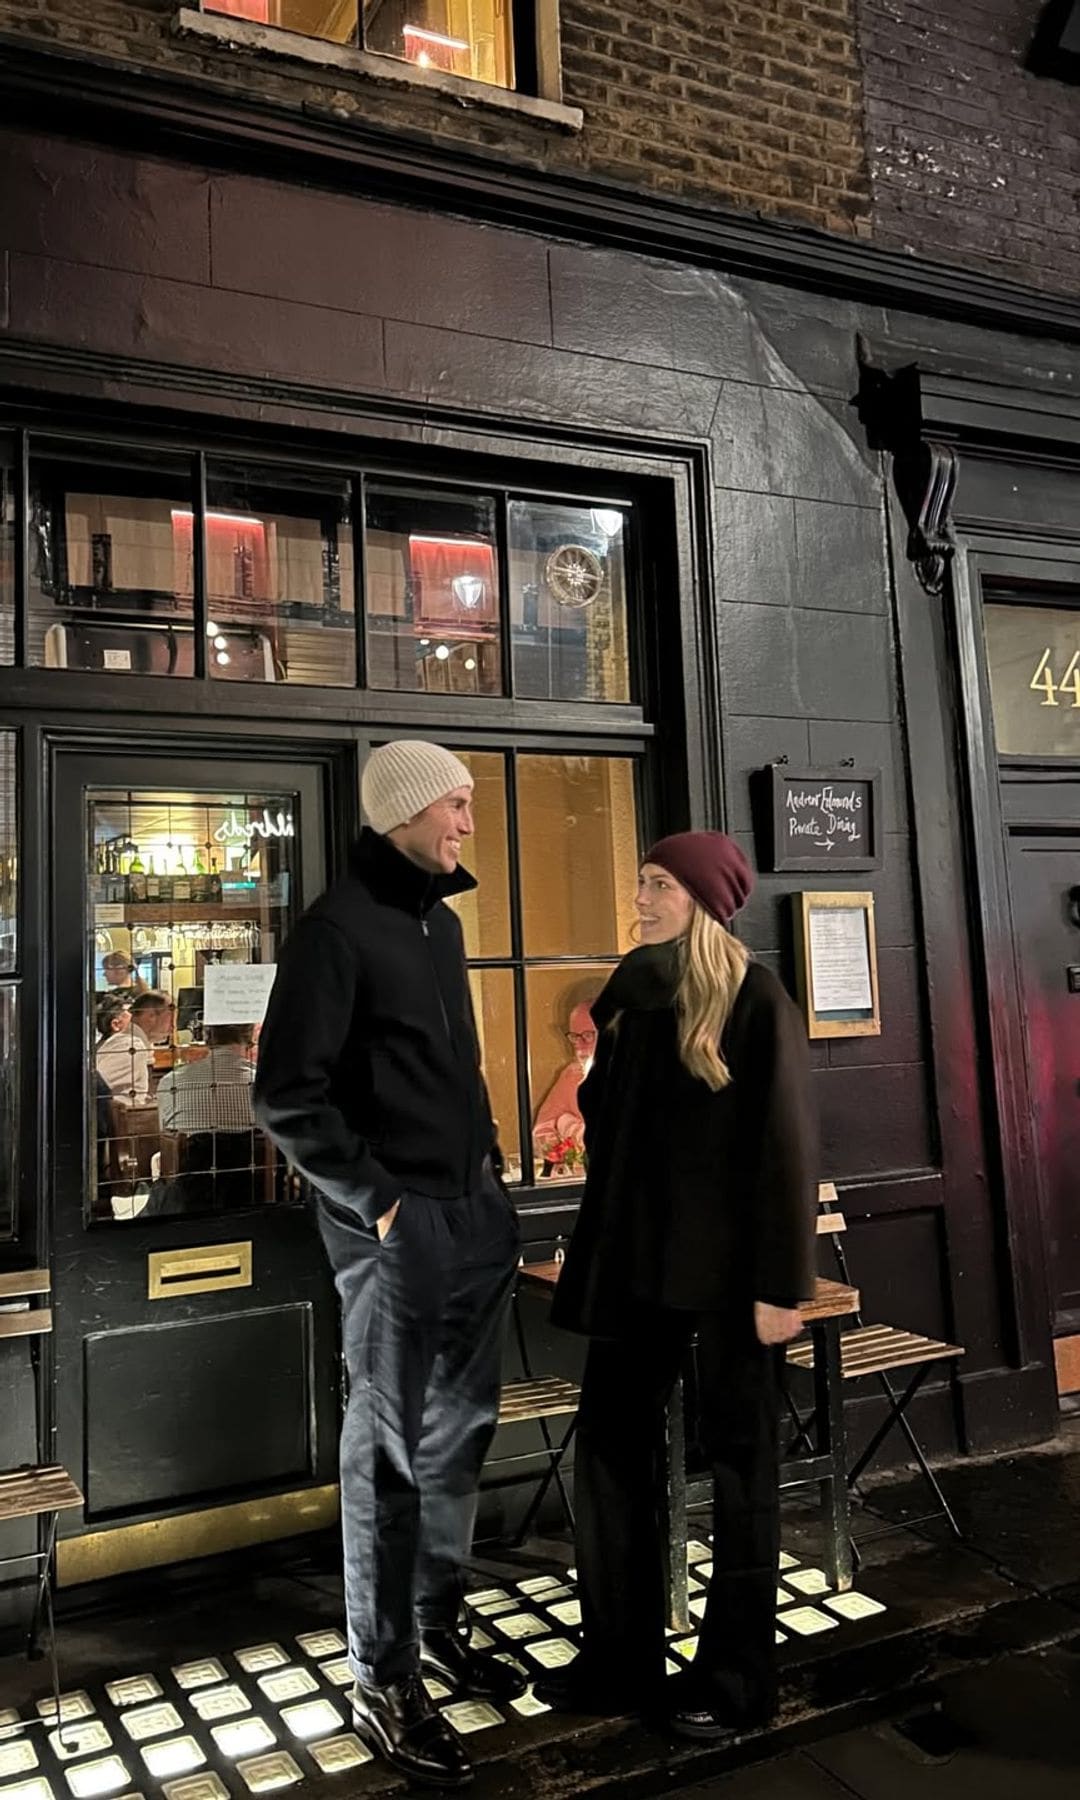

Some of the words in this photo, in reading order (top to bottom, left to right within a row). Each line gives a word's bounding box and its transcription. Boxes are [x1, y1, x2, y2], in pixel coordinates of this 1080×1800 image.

[1029, 647, 1080, 708] 44
[786, 789, 821, 813] Andrew
[788, 817, 823, 837] Private
[826, 813, 862, 842] Dining
